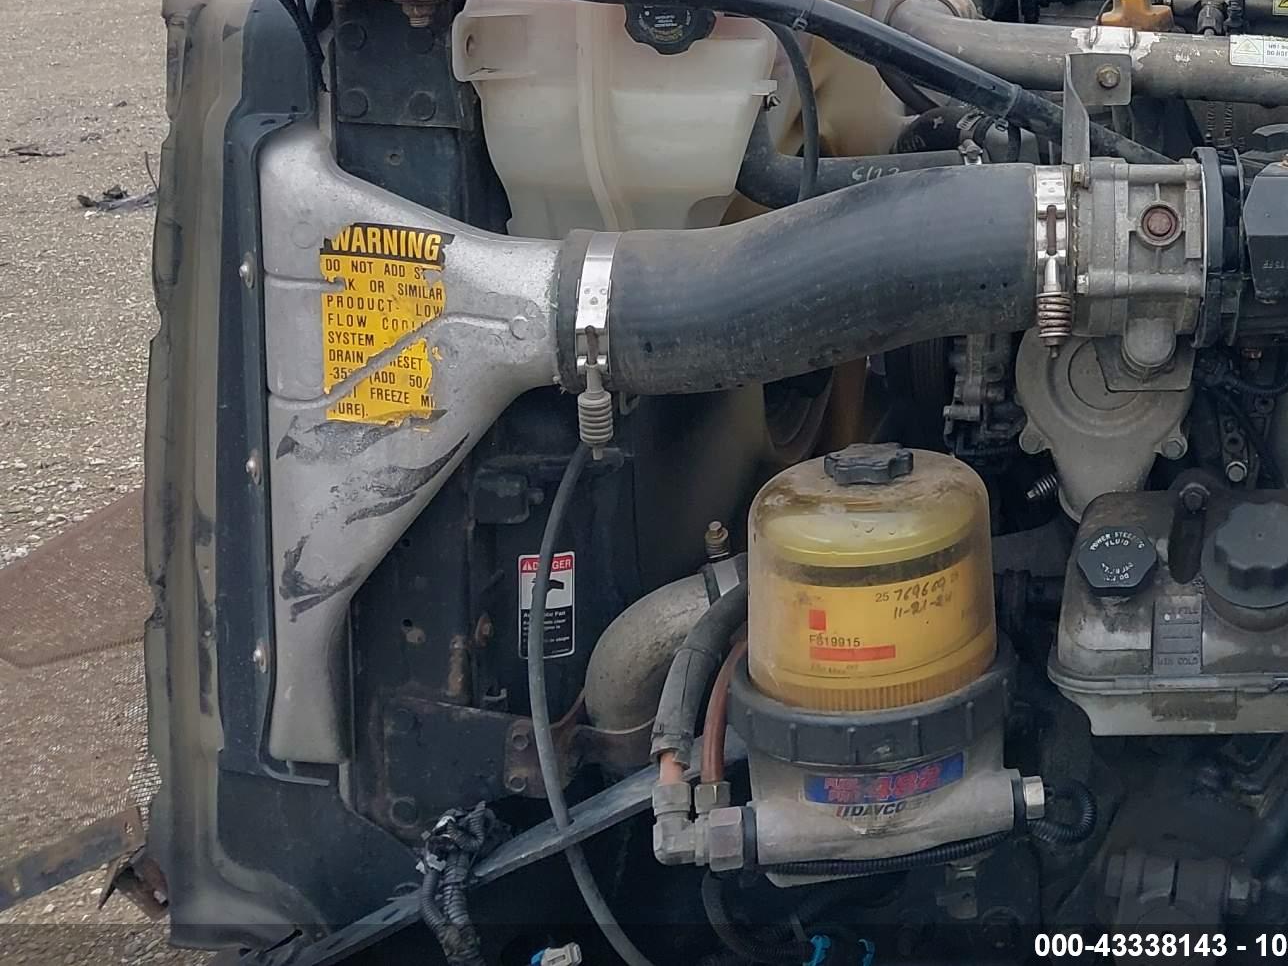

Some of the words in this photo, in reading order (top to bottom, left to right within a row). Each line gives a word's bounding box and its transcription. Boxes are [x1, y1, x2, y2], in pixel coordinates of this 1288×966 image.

[331, 226, 442, 261] WARNING
[325, 258, 340, 272] DO
[351, 260, 374, 275] NOT
[384, 262, 406, 278] ADD
[369, 280, 385, 294] OR
[397, 282, 443, 301] SIMILAR
[415, 304, 443, 319] LOW
[327, 313, 367, 328] FLOW
[327, 331, 375, 347] SYSTEM
[328, 348, 364, 364] DRAIN
[369, 371, 396, 386] (ADD
[370, 387, 410, 405] FREEZE
[1090, 533, 1112, 551] POWER
[1104, 538, 1130, 548] FLUID
[875, 592, 891, 603] 25
